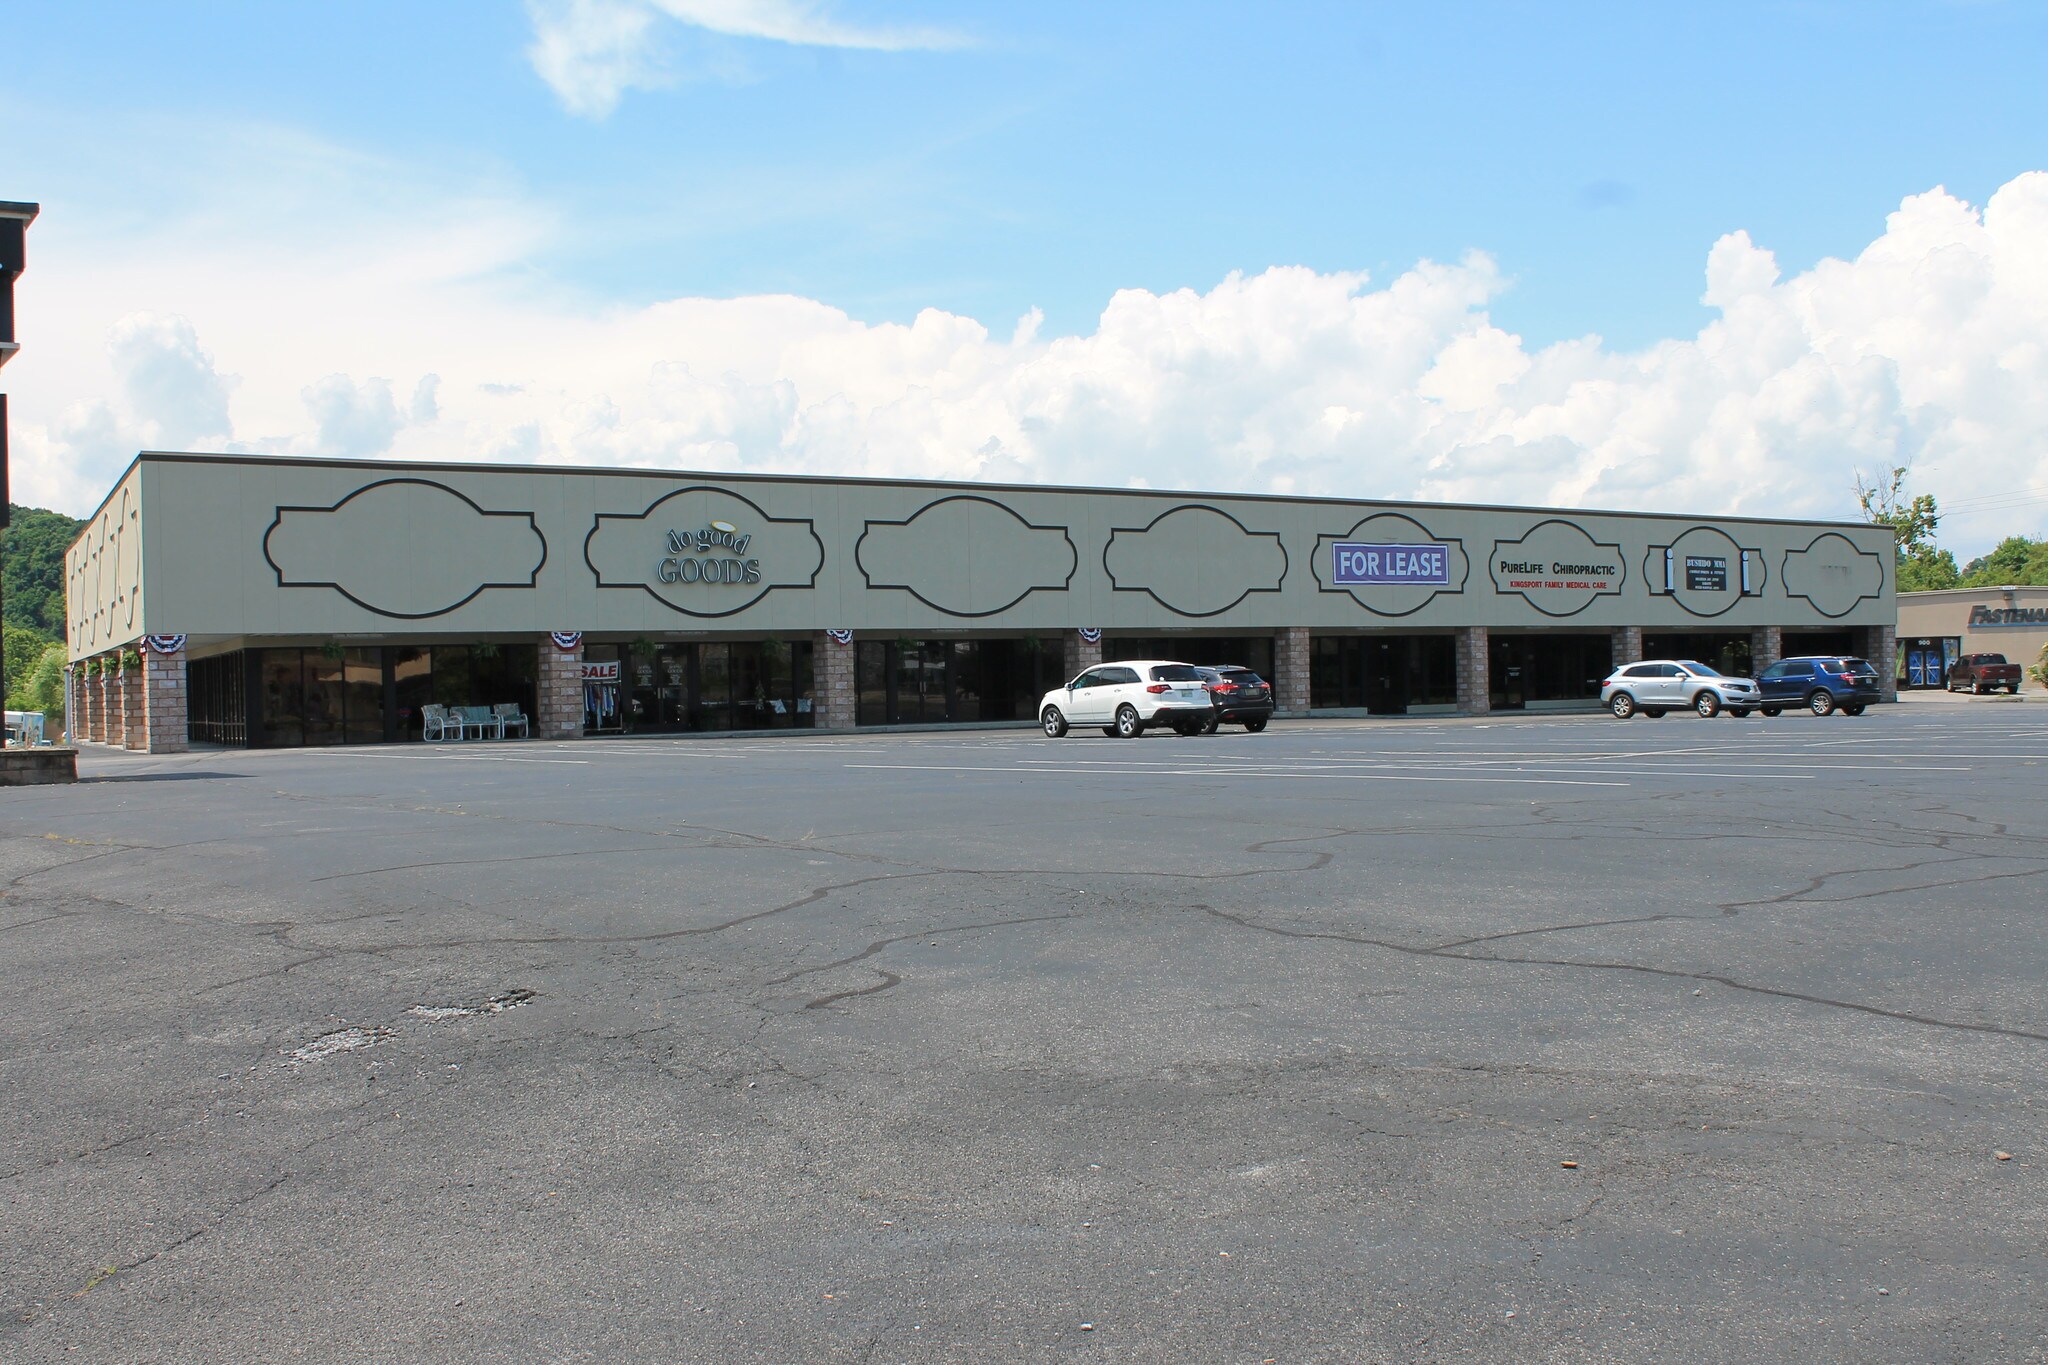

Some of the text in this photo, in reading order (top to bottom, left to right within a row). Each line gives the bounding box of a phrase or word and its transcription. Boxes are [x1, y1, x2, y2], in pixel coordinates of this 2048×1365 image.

[667, 528, 752, 556] do good
[657, 557, 761, 585] GOODS
[1340, 551, 1442, 577] FOR LEASE
[1510, 581, 1542, 589] KINGSPORT
[1544, 581, 1563, 589] FAMILY
[1566, 581, 1590, 589] MEDICAL
[1968, 605, 2048, 625] FASTENA
[582, 665, 617, 678] SALE
